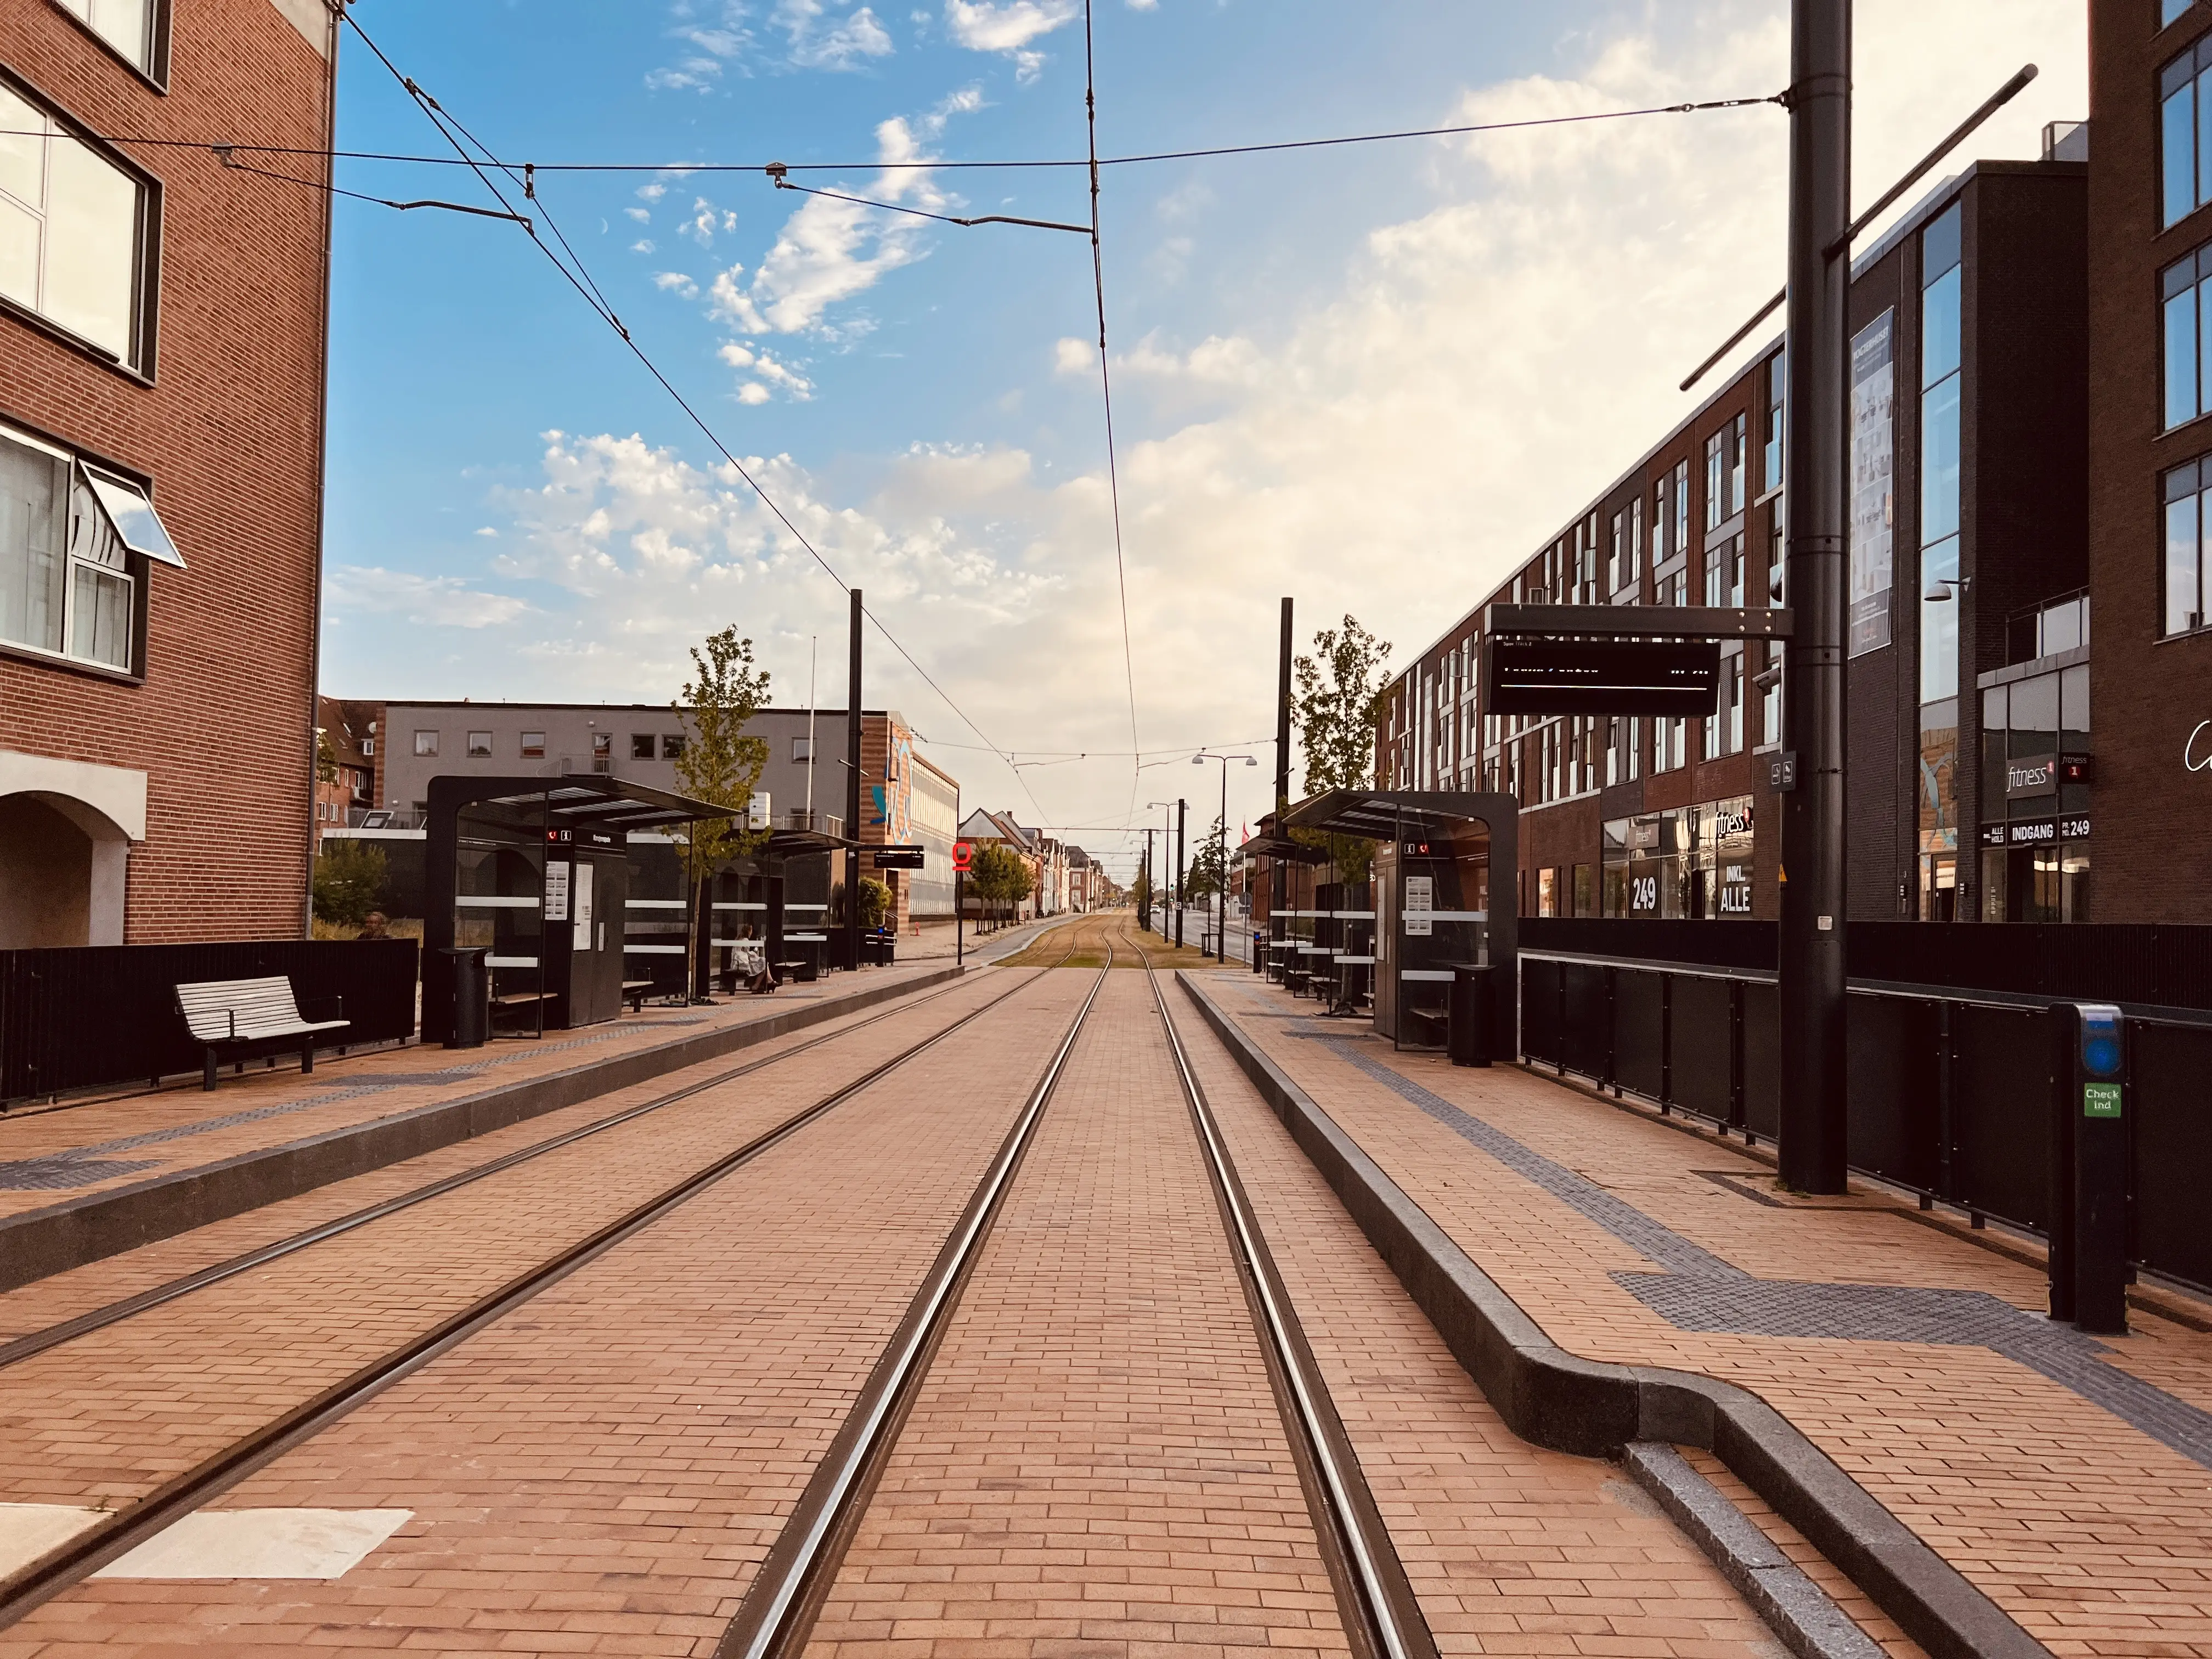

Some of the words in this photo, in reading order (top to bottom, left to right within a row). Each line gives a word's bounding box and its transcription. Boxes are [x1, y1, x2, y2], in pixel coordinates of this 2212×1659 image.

[2062, 755, 2087, 764] fitness
[2006, 767, 2046, 792] fitness
[1715, 811, 1743, 838] fitness
[2012, 824, 2053, 840] INDGANG
[2070, 820, 2090, 836] 249
[1726, 865, 1745, 882] INKL.
[1633, 877, 1656, 910] 249
[1720, 886, 1750, 912] ALLE
[2086, 1089, 2119, 1099] Check
[2094, 1101, 2112, 1109] ind
